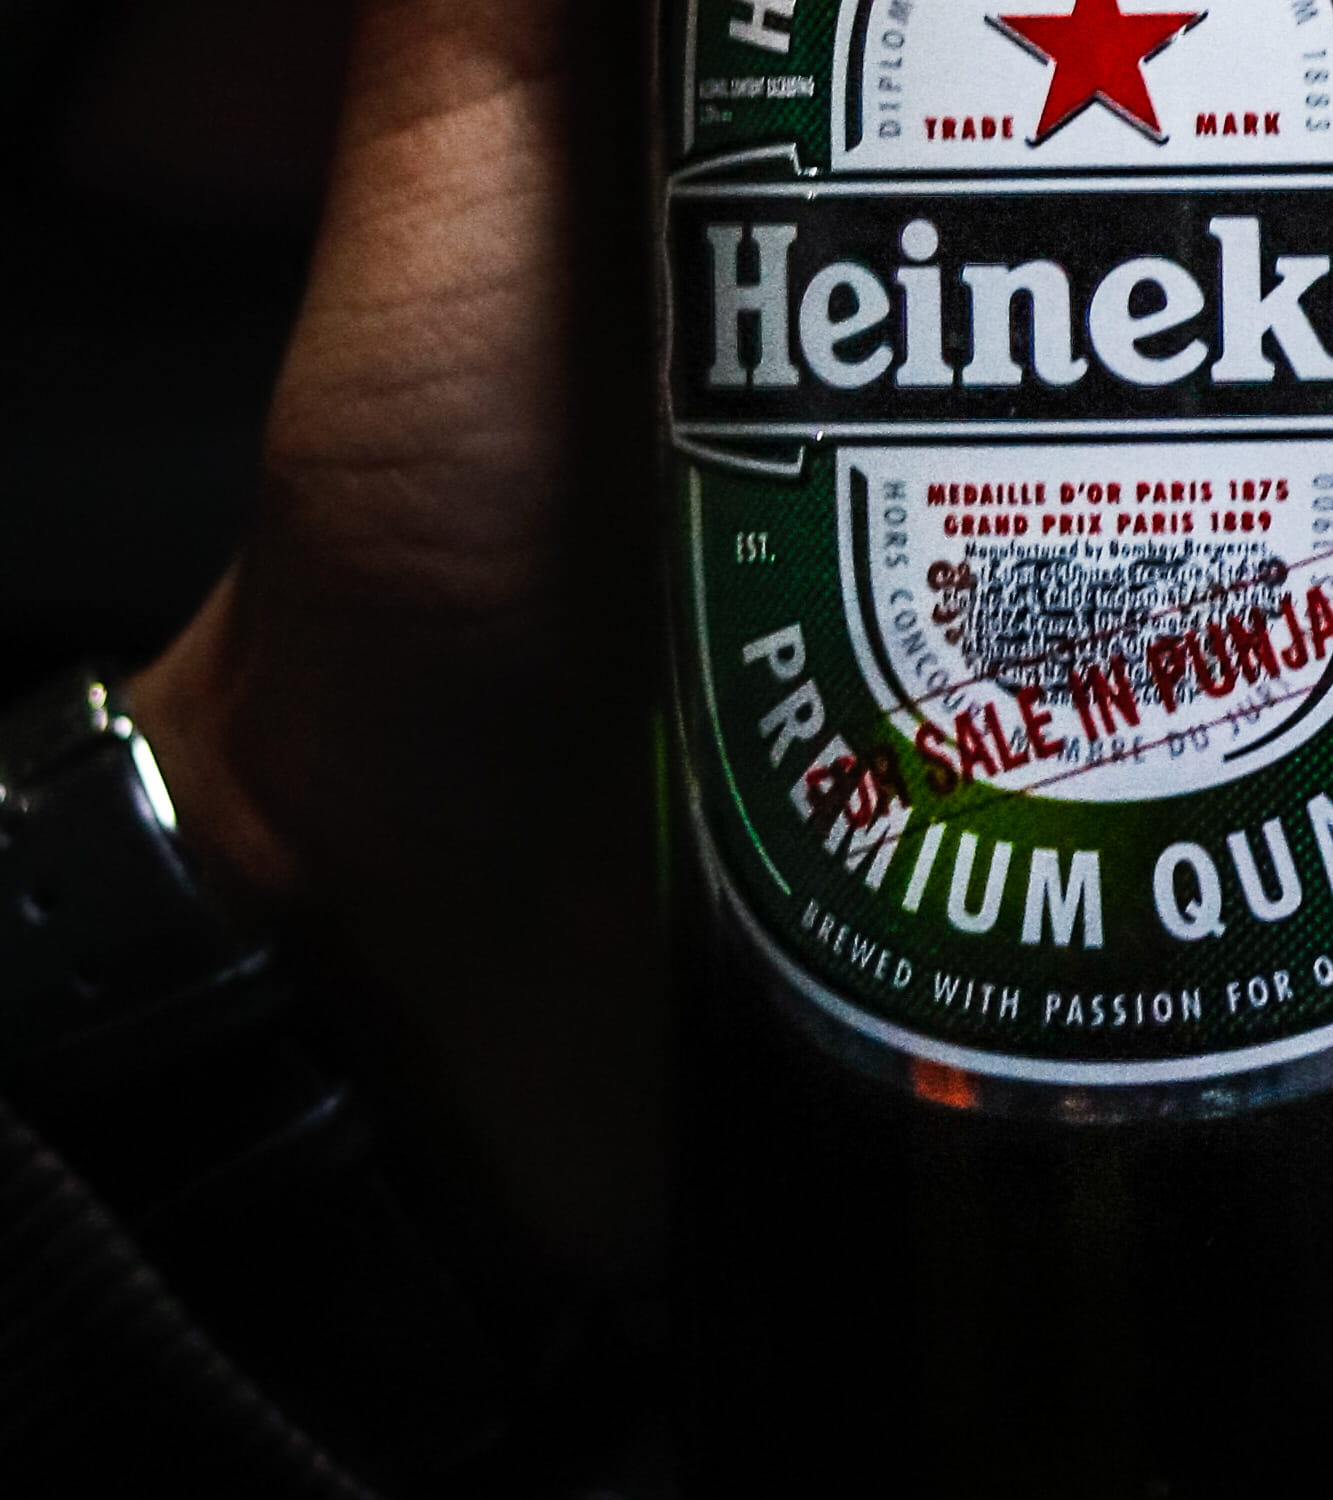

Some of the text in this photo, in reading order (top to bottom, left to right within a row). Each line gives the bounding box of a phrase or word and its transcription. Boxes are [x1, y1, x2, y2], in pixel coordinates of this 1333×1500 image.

[923, 111, 1281, 142] TRADE MARK
[883, 479, 910, 569] HORS
[926, 478, 1290, 507] MEDAILLE D'OR PARIS 1875
[943, 509, 1273, 537] GRAND PRIX PARIS 1889
[735, 530, 777, 564] EST.
[889, 588, 992, 731] CONCOU
[913, 686, 1064, 796] SALE
[1068, 655, 1141, 741] IN
[743, 621, 1107, 951] PREMIUM
[801, 898, 915, 993] BREWED
[931, 969, 1022, 1021] WITH
[1044, 986, 1202, 1026] PASSION
[1226, 968, 1295, 1012] FOR
